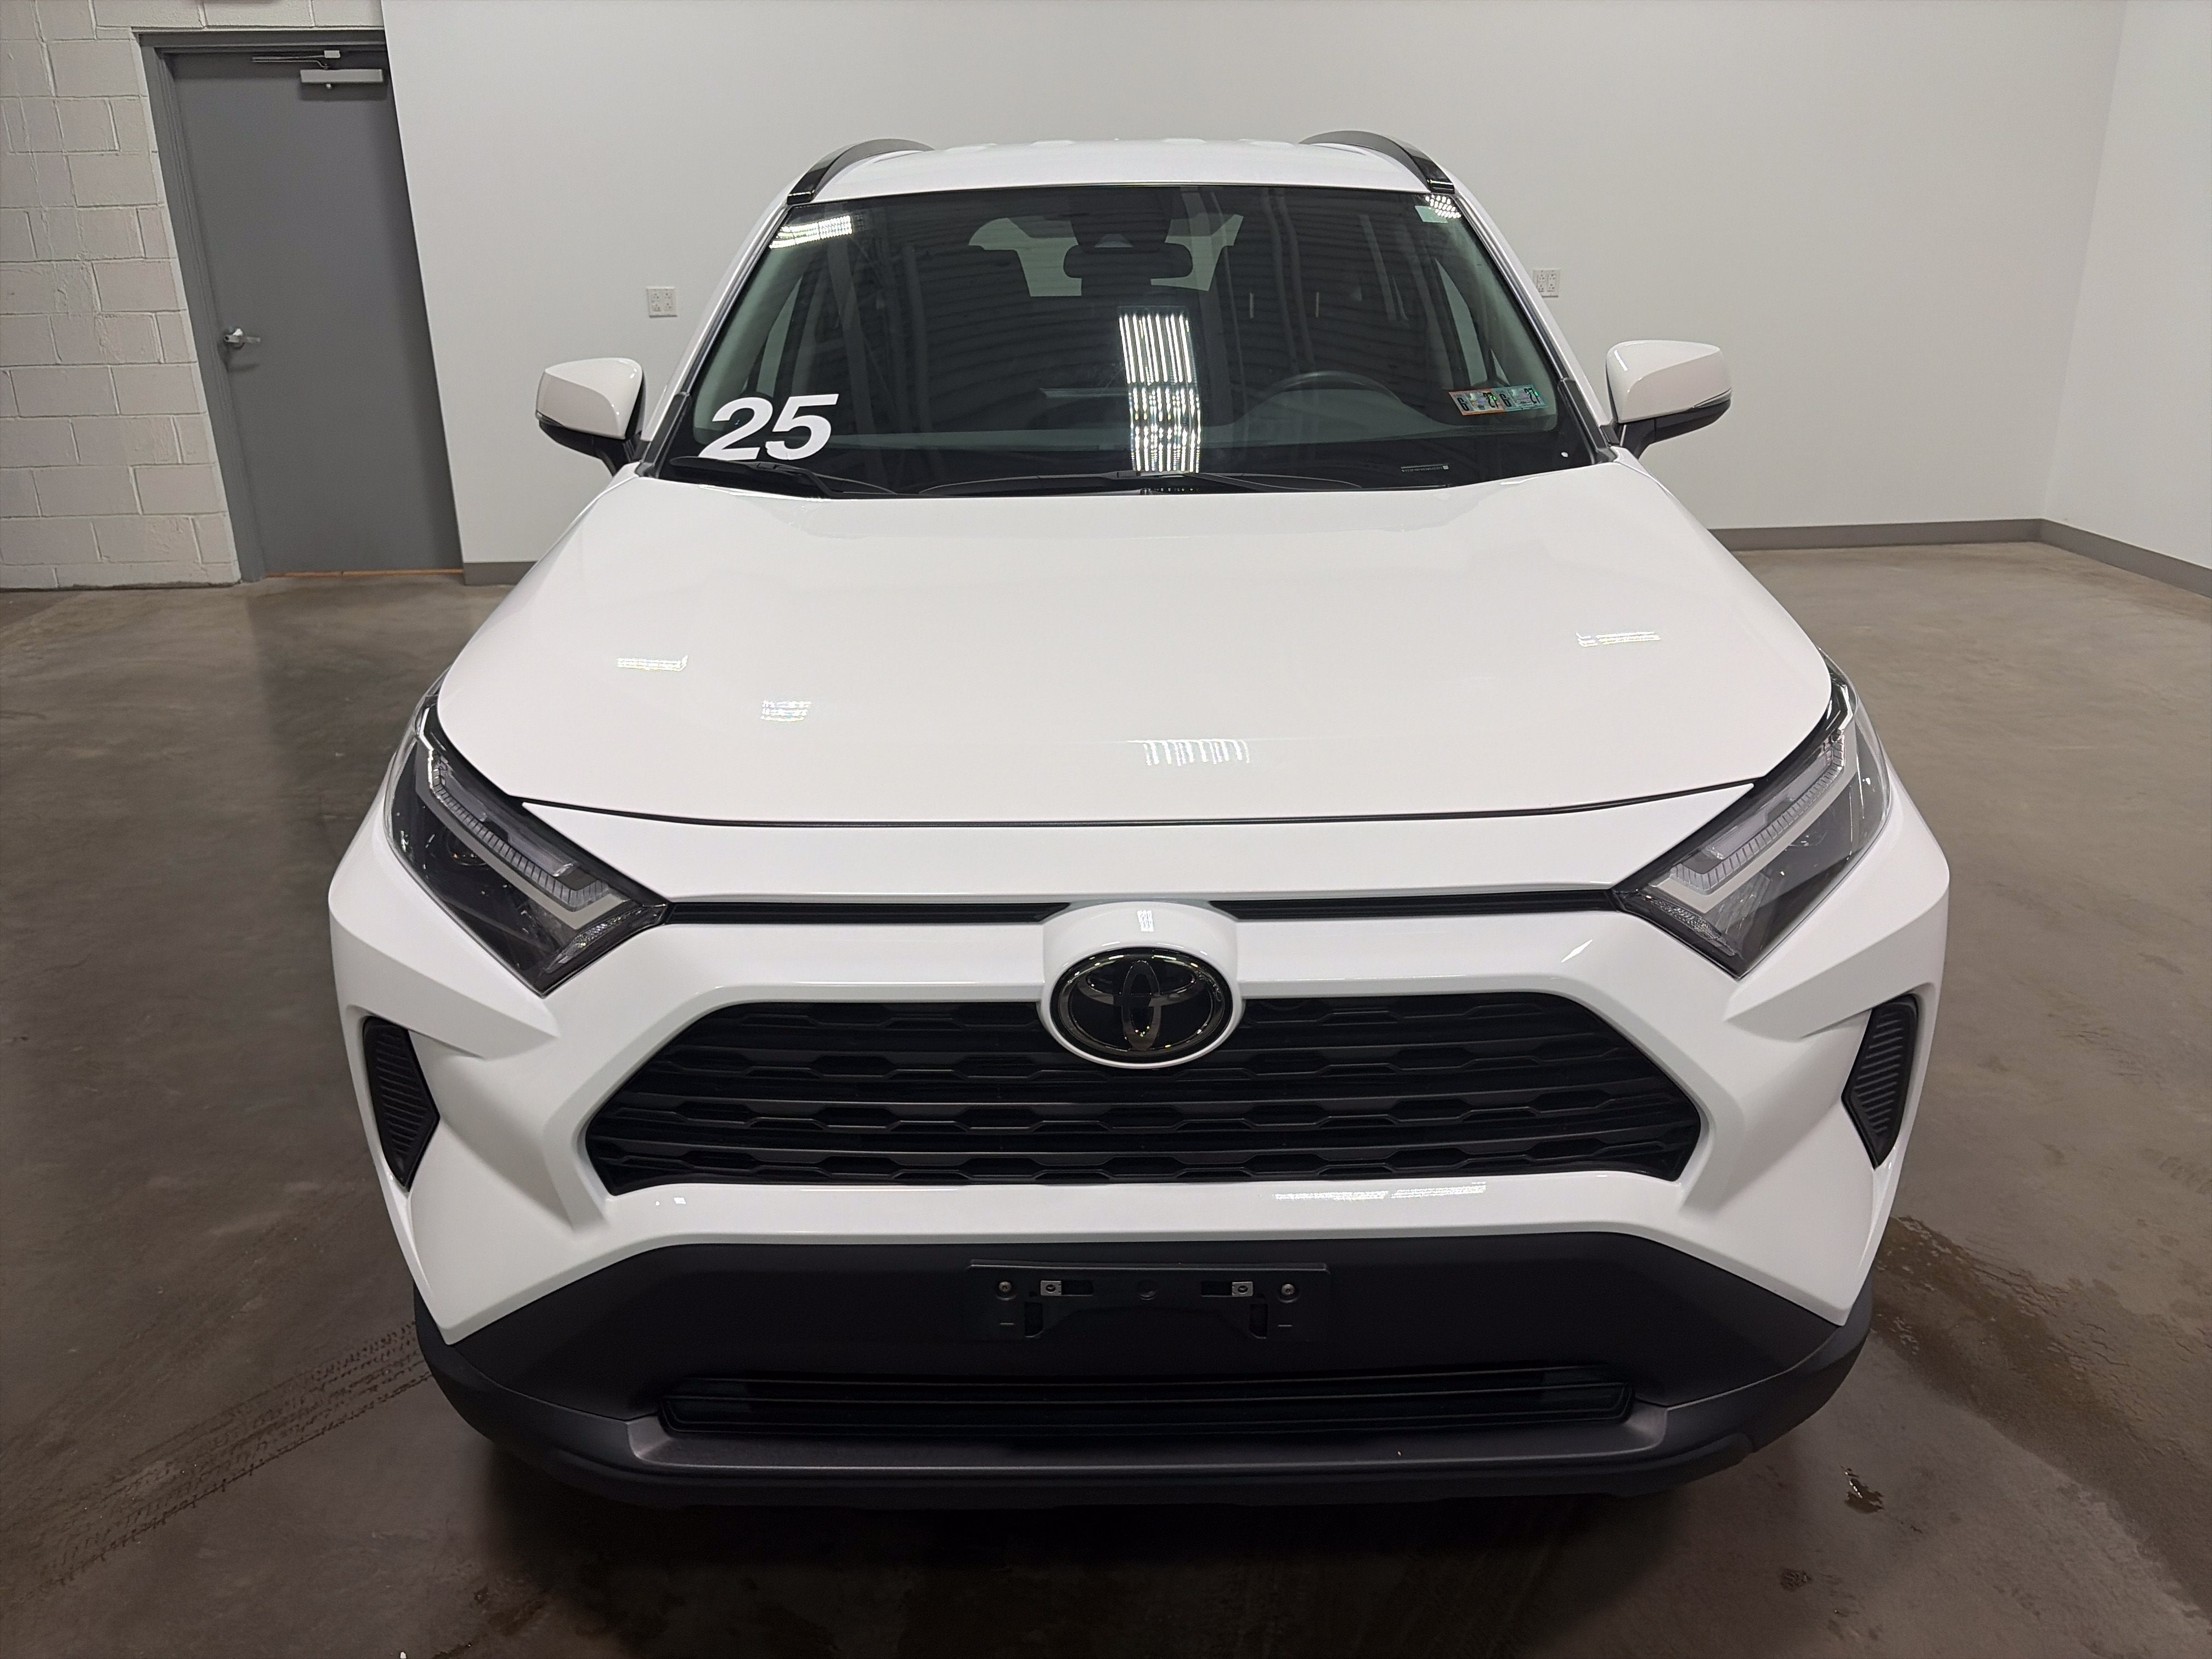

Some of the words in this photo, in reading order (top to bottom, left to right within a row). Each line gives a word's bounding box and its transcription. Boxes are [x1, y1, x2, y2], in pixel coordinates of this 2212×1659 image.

[1457, 397, 1470, 411] 6
[1499, 393, 1512, 407] 6
[698, 394, 839, 460] 25
